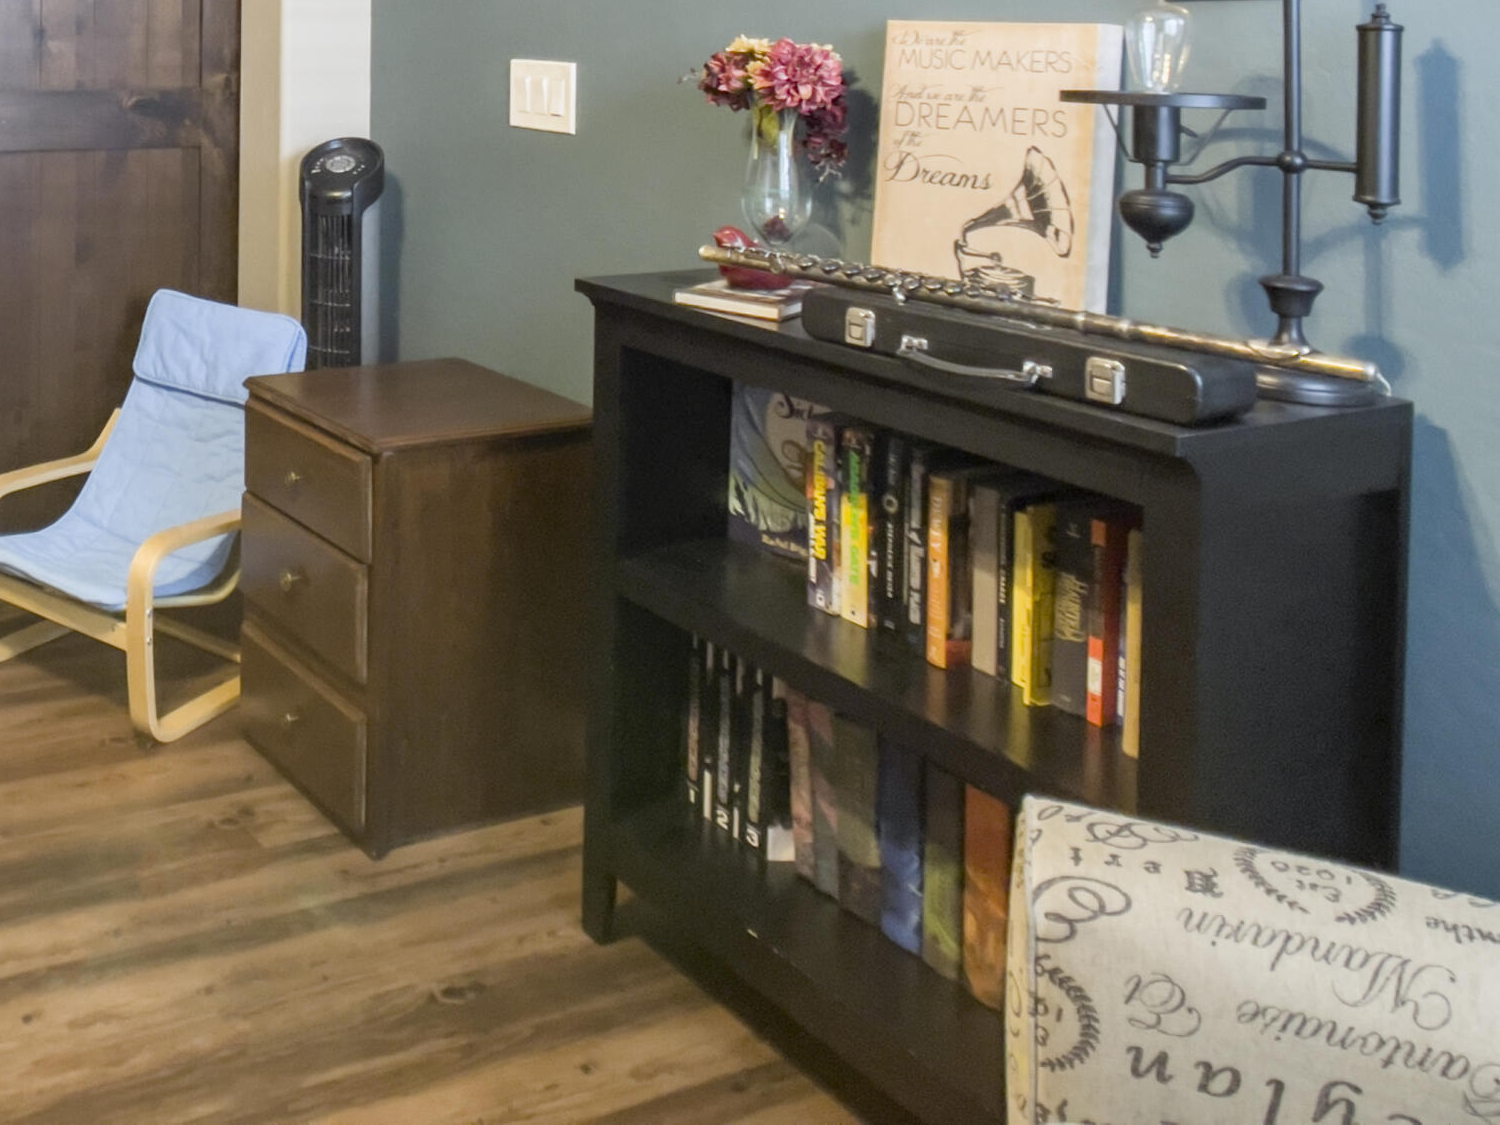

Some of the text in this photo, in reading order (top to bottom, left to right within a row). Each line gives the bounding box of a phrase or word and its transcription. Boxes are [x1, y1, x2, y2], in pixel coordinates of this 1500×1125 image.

[925, 35, 945, 46] are
[898, 48, 1073, 74] MUSIC MAKERS
[967, 86, 991, 102] the
[894, 101, 1068, 138] DREAMERS
[883, 150, 992, 191] Dreams
[1176, 905, 1456, 1031] Mandarin
